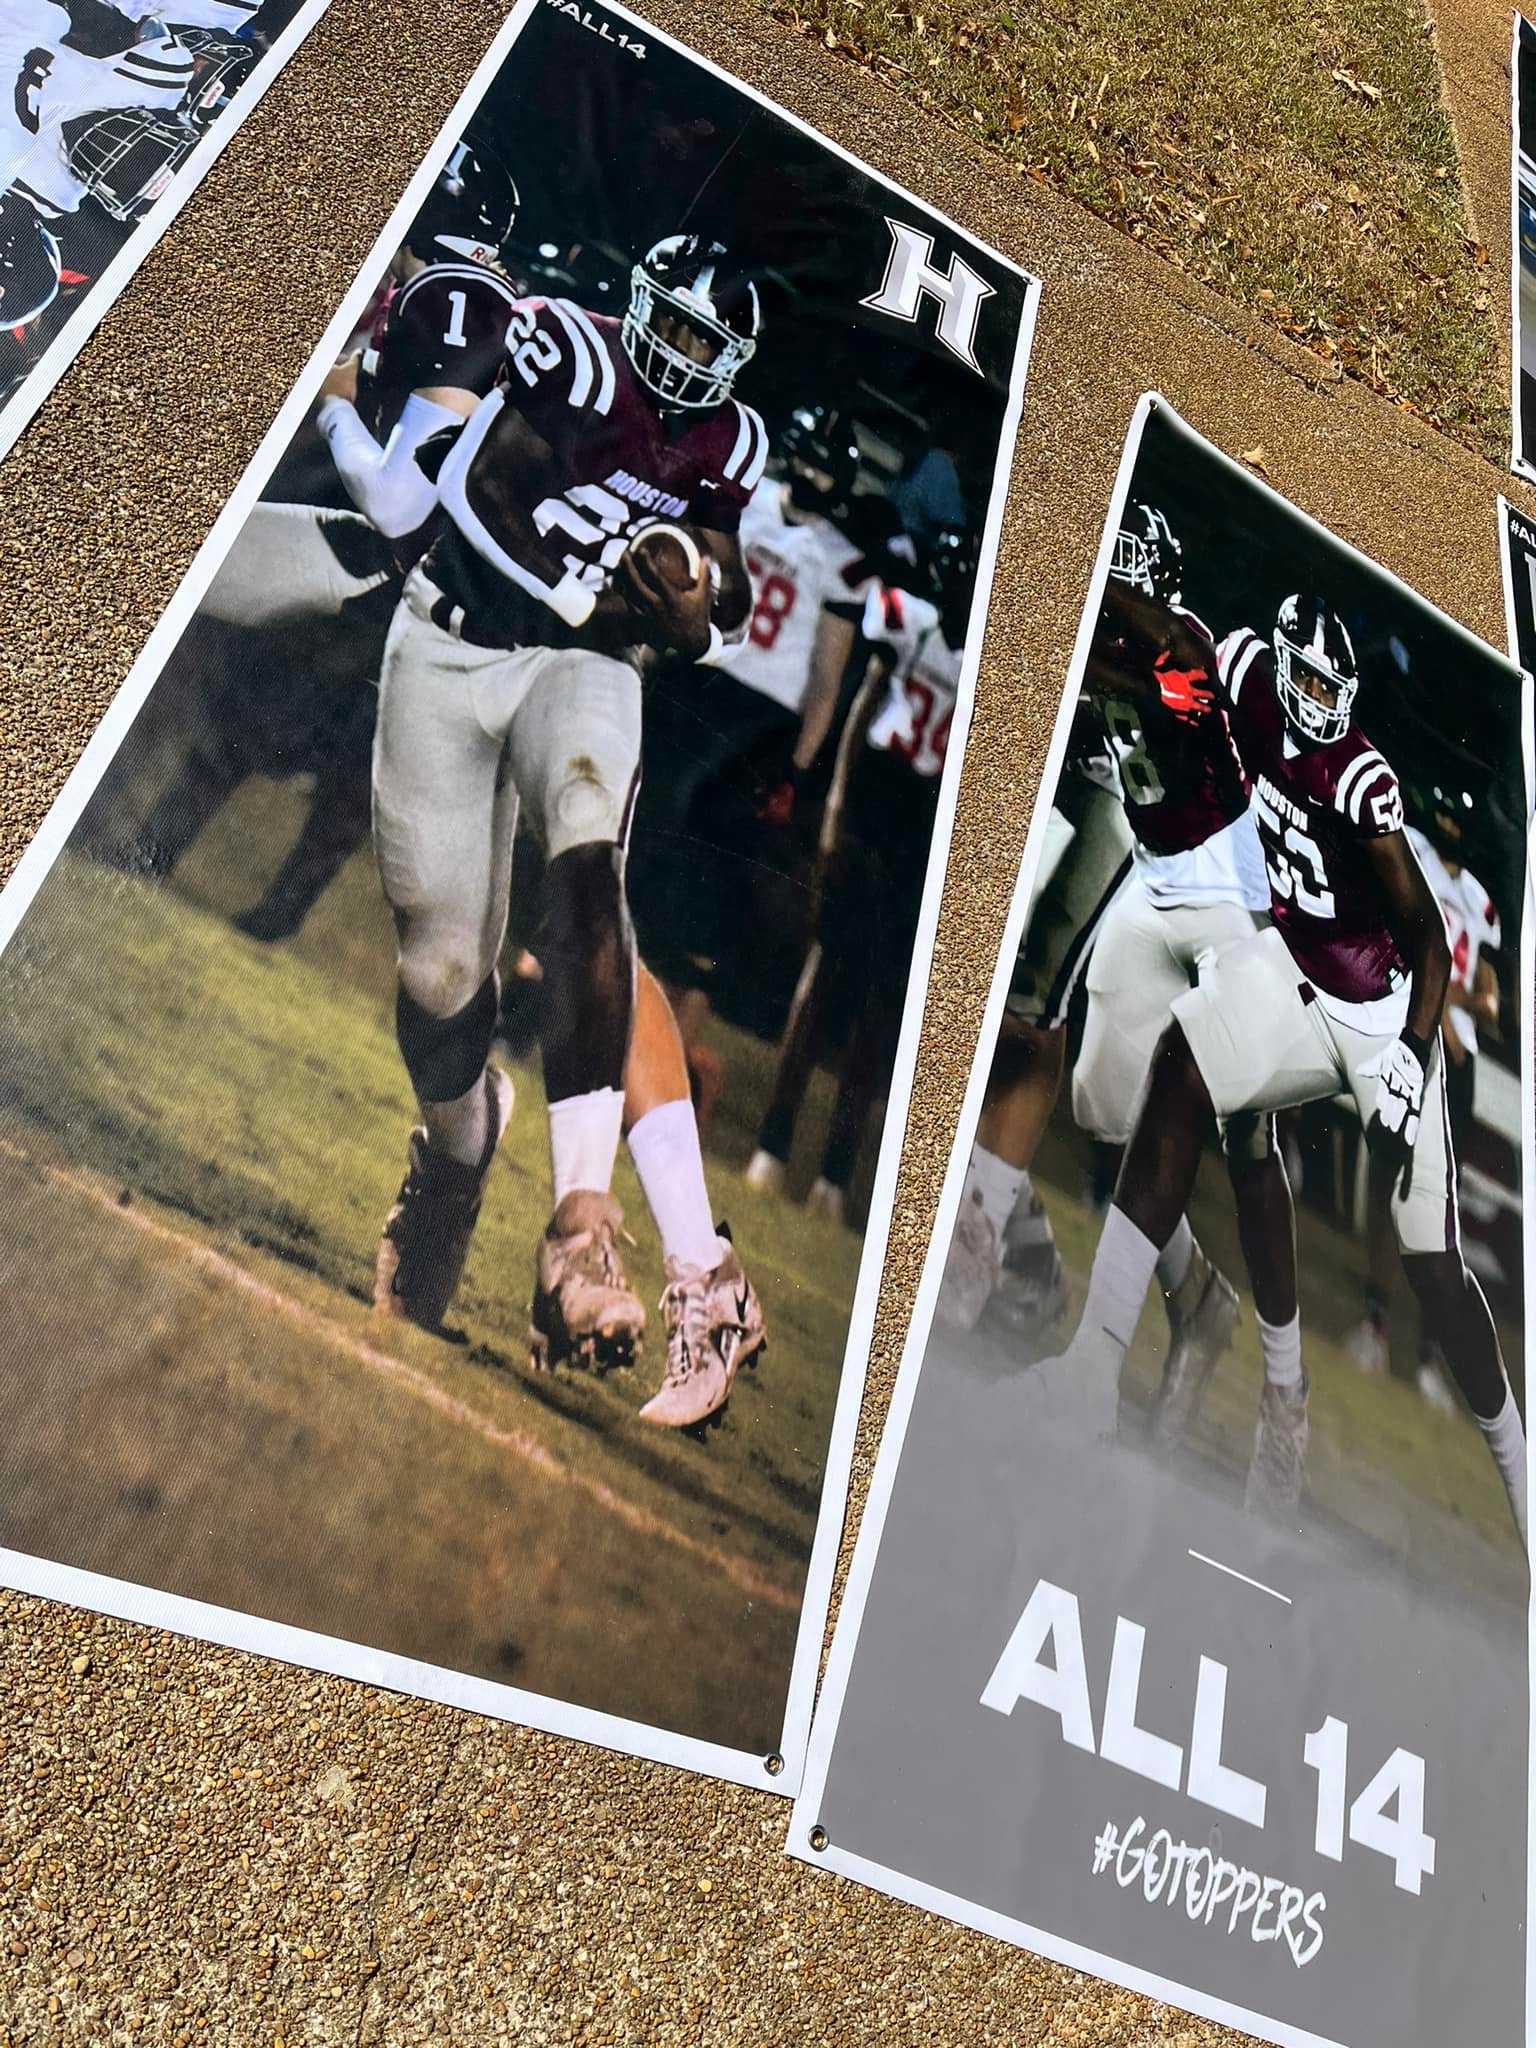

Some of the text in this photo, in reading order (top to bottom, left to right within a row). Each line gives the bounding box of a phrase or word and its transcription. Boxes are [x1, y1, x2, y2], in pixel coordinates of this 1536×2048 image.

[443, 290, 468, 348] 1
[858, 215, 998, 379] H
[504, 306, 562, 388] 22
[602, 468, 689, 518] HOUSTON
[1256, 773, 1308, 832] HOUSTON
[1369, 785, 1404, 834] 52
[979, 1578, 1436, 1896] ALL 14
[1091, 1815, 1328, 1969] #GOTOPPERS
